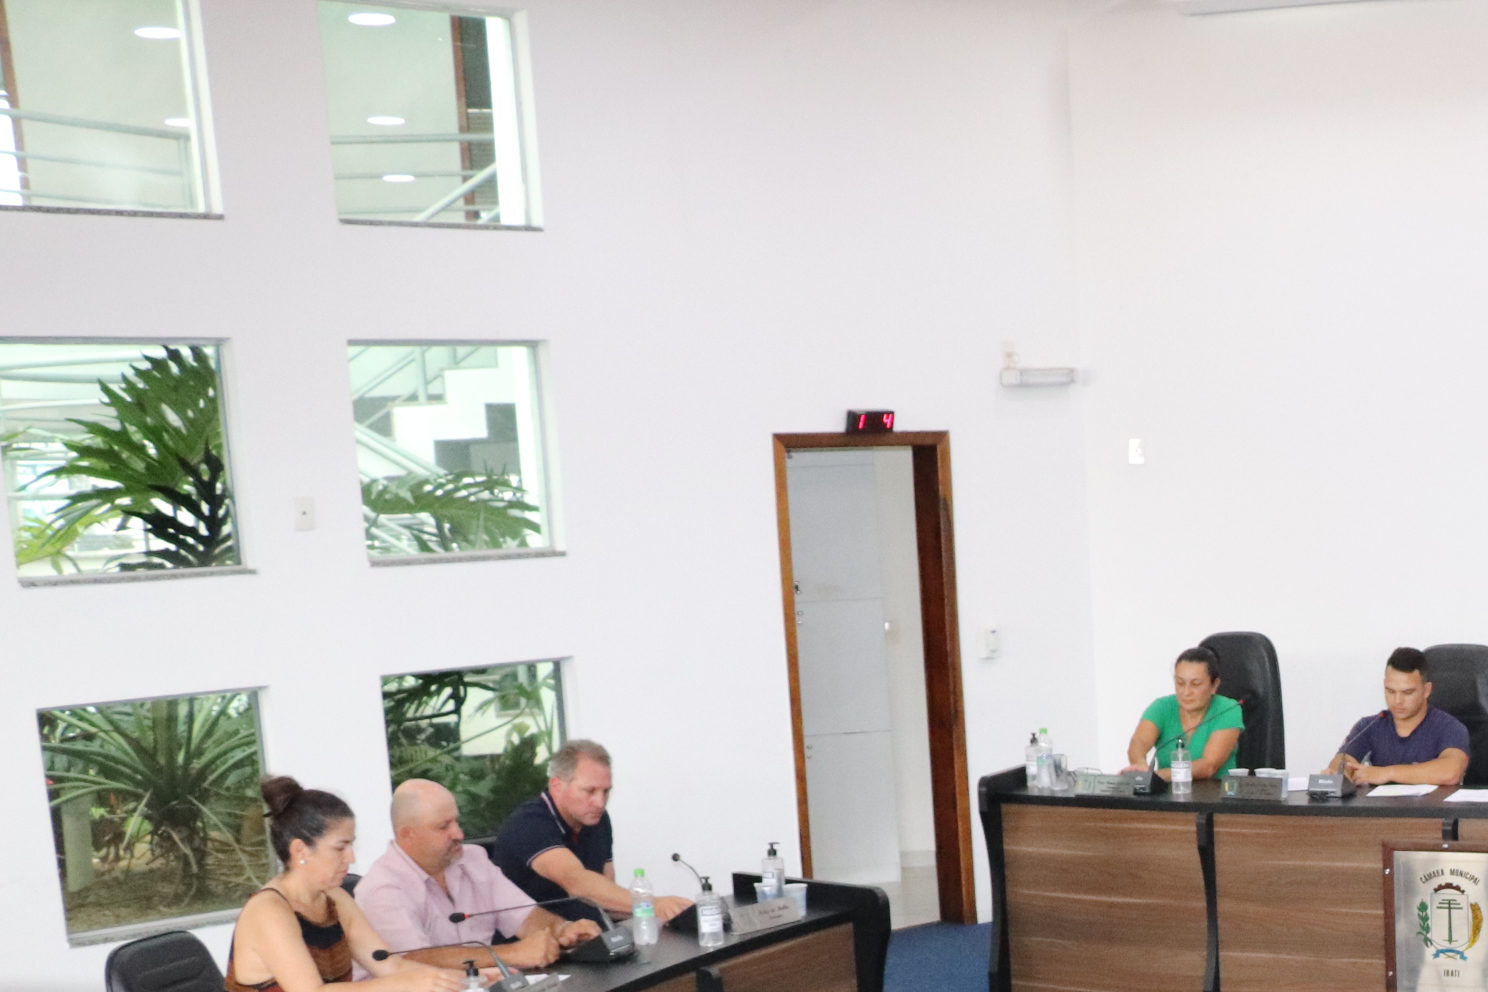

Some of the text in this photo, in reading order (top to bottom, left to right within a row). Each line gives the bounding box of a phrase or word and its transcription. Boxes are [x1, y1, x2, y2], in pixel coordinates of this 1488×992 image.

[882, 413, 895, 429] 4
[1449, 868, 1481, 886] MUNICIPAL
[1443, 969, 1460, 978] IRATI
